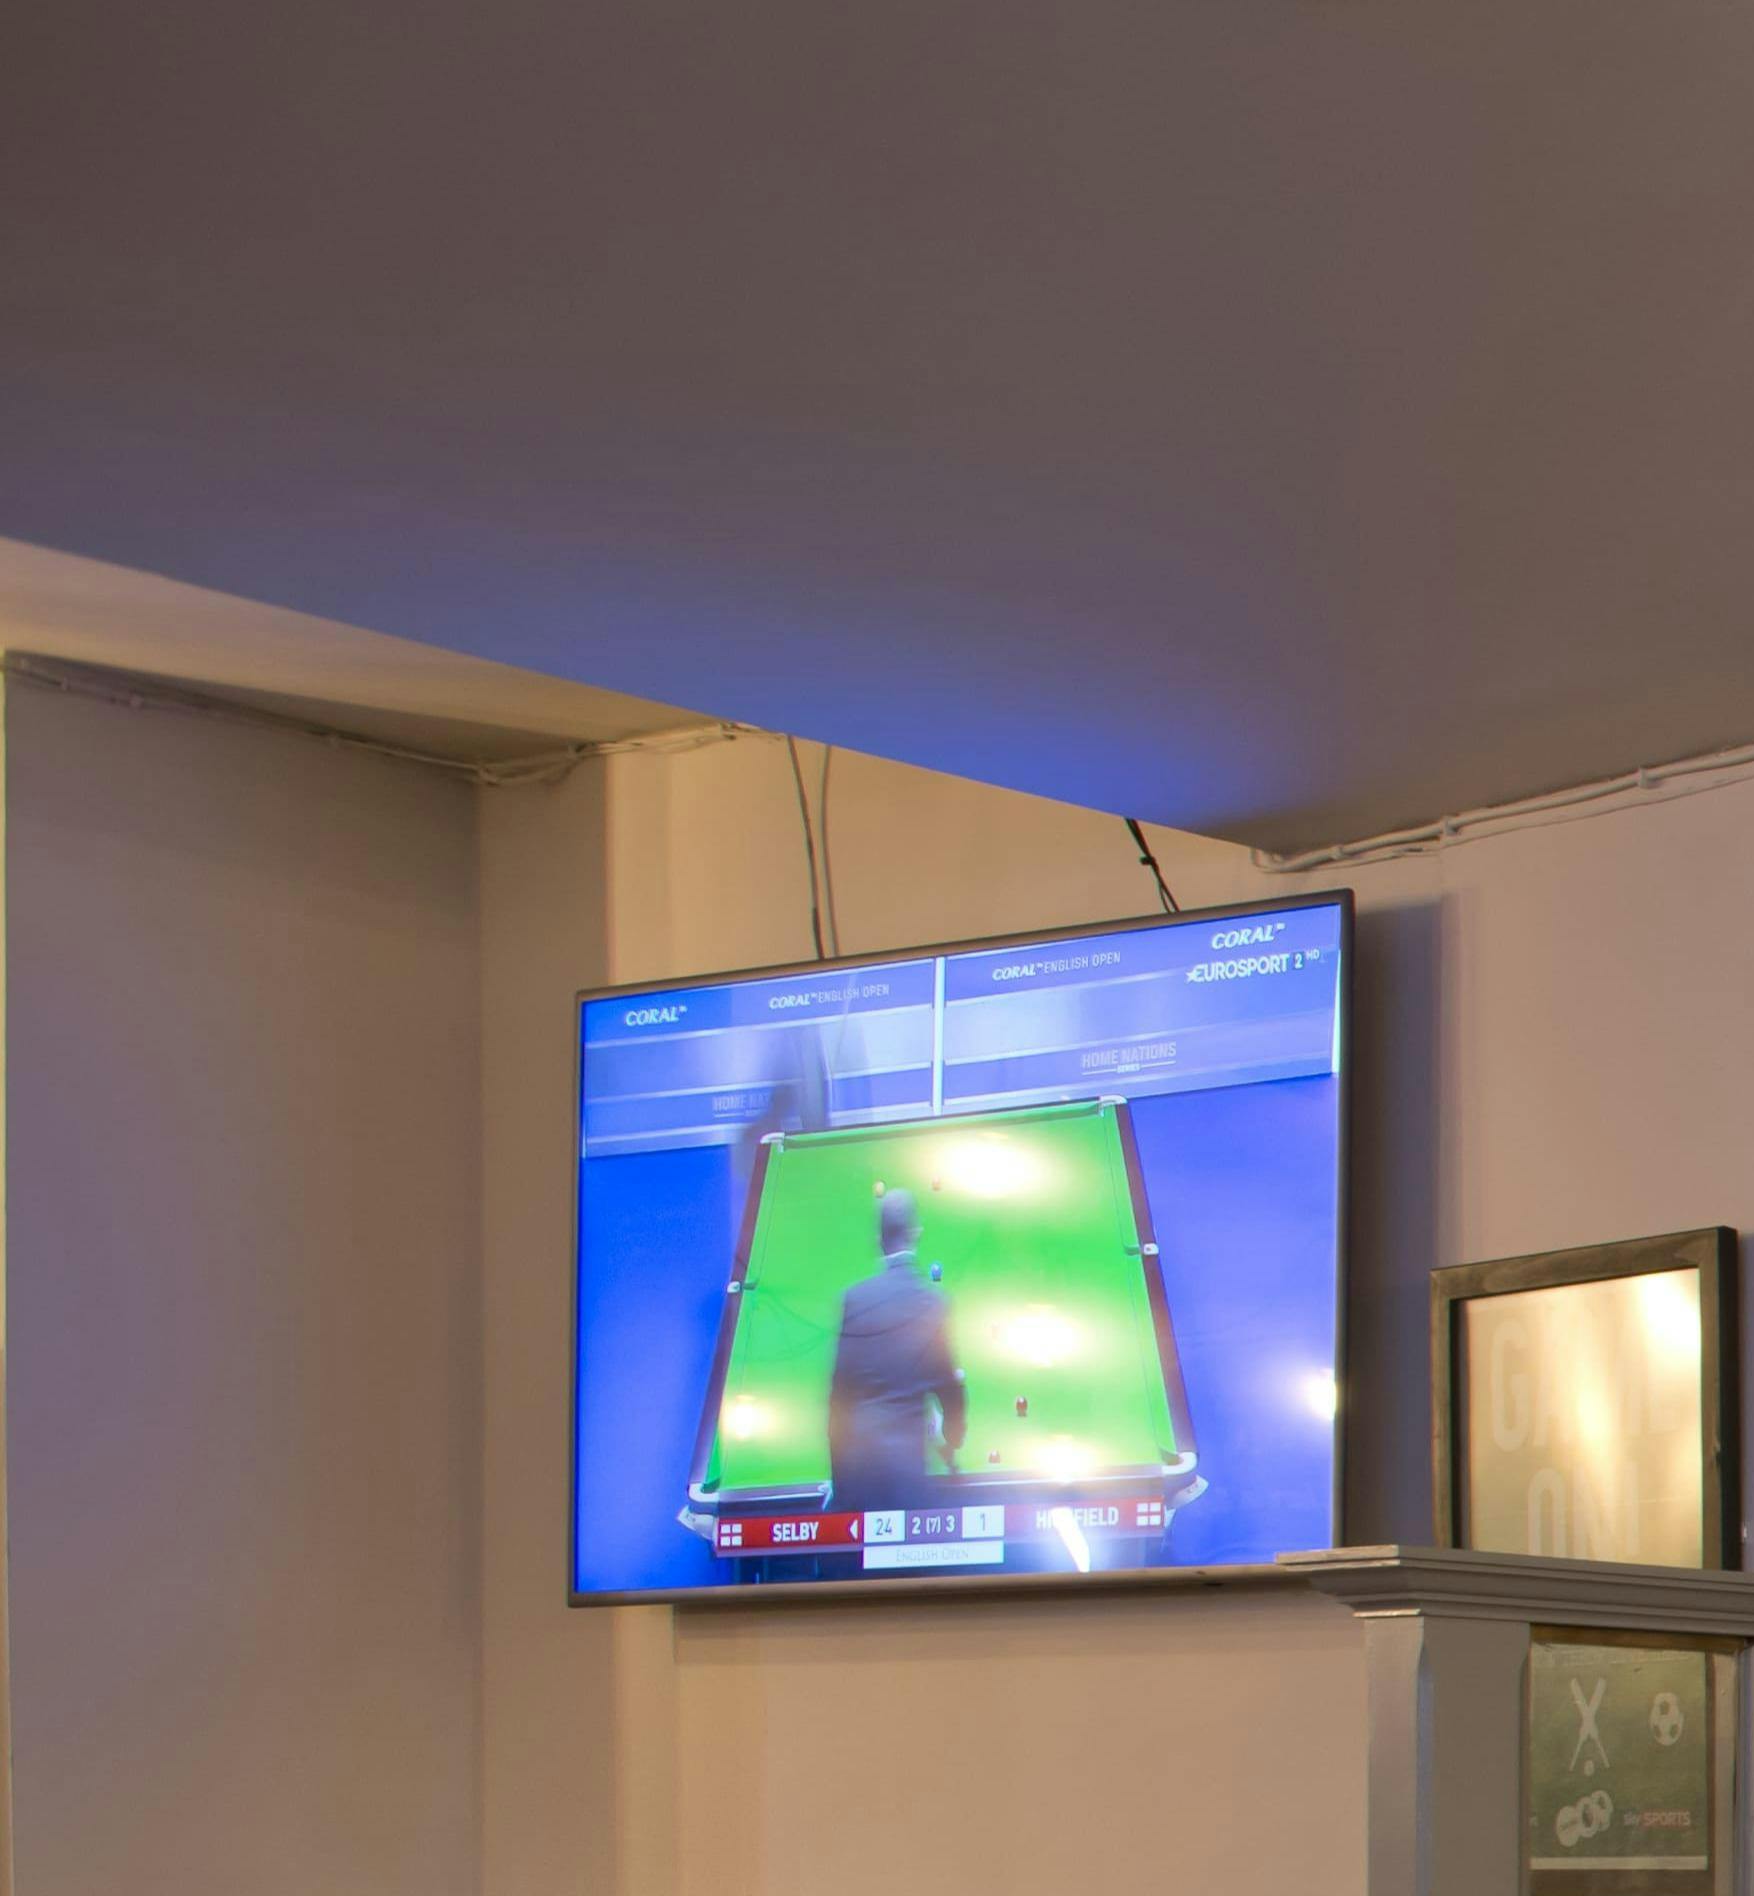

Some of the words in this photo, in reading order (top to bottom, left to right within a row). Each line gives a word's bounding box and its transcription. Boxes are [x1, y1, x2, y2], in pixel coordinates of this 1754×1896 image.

[1211, 925, 1275, 950] CORAL
[992, 963, 1037, 982] CORAL
[1043, 957, 1090, 975] ENGLISH
[1092, 951, 1121, 968] OPEN
[1190, 952, 1289, 984] EUROSPORT
[1294, 952, 1304, 970] 2
[768, 993, 812, 1010] CORAL
[817, 988, 860, 1003] ENGLISH
[863, 983, 891, 998] OPEN
[625, 1005, 680, 1027] CORAL
[1081, 1046, 1120, 1070] HOME
[1121, 1040, 1177, 1064] NATIONS
[772, 1521, 820, 1542] SELBY
[875, 1520, 894, 1537] 24
[911, 1516, 922, 1535] 2
[925, 1515, 942, 1535] (7)
[945, 1514, 956, 1533] 3
[979, 1512, 987, 1533] 1
[1036, 1504, 1120, 1529] HIFIELD
[1643, 1811, 1691, 1827] SPORTS
